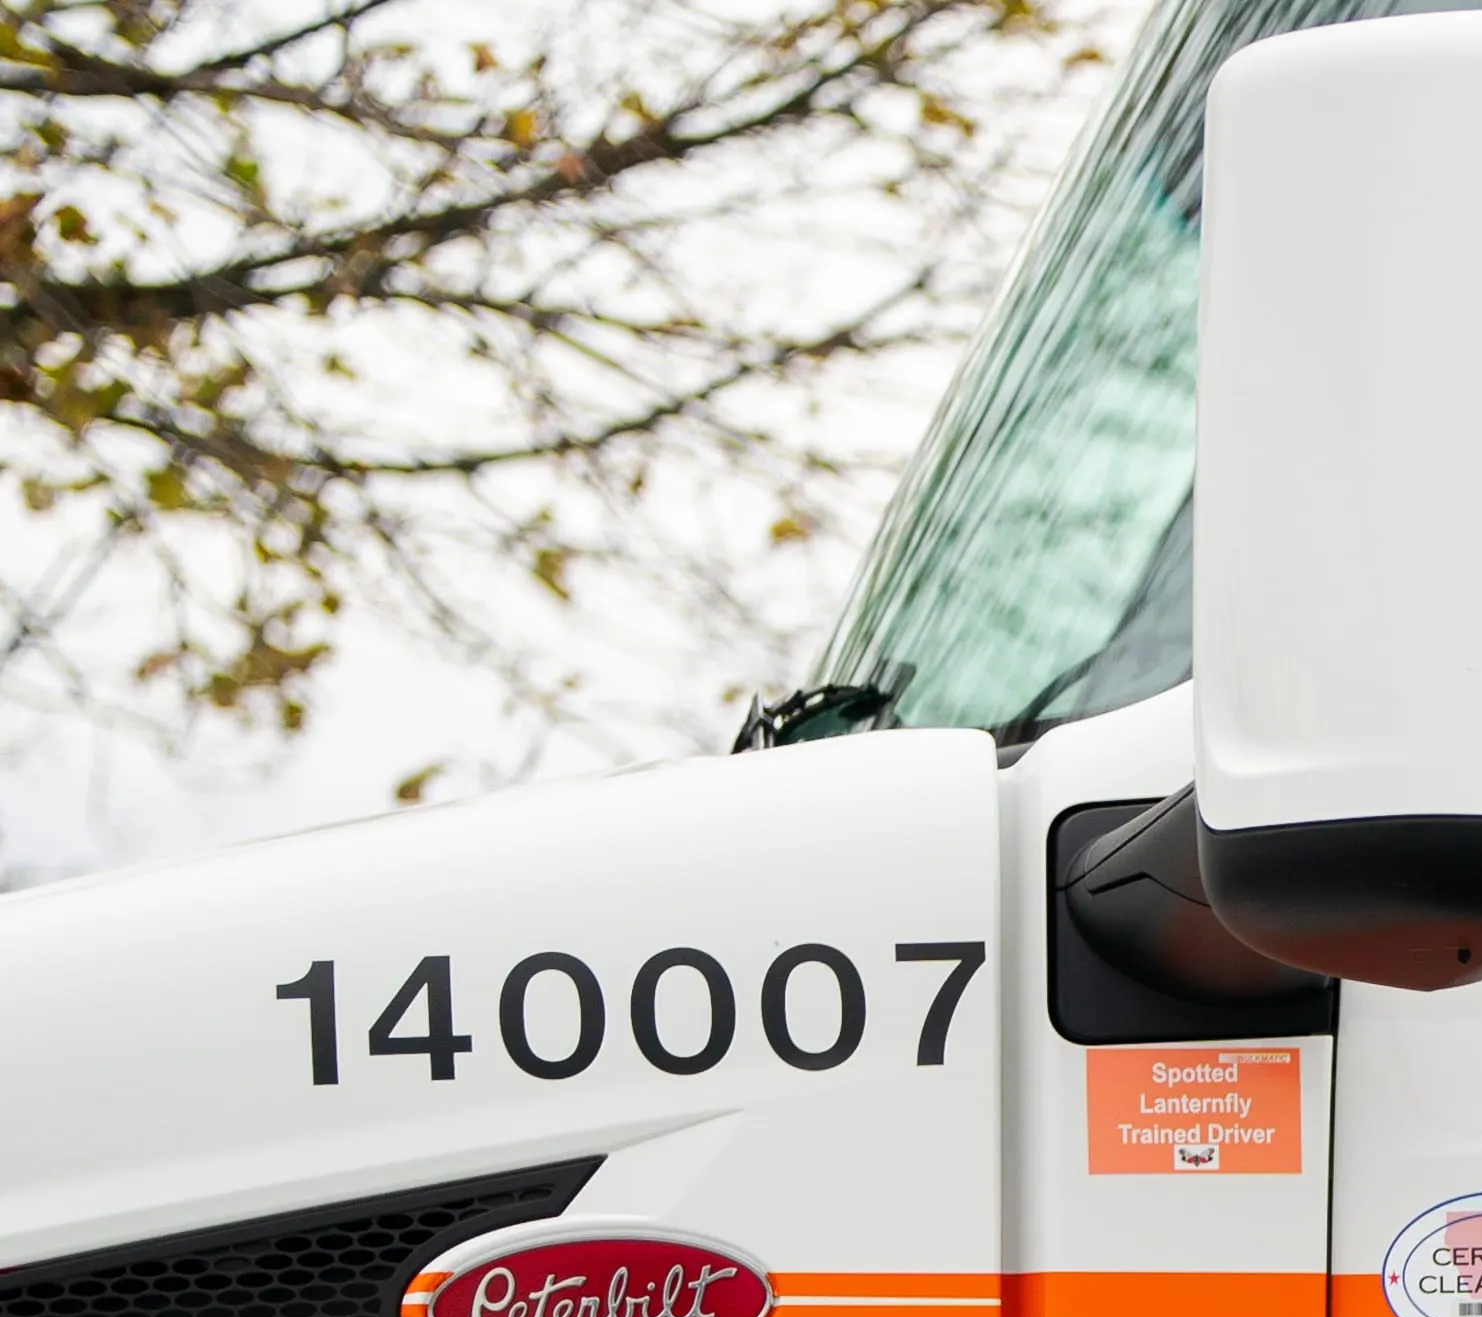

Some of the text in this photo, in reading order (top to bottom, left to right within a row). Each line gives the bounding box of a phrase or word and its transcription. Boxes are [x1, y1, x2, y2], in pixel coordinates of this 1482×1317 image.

[275, 941, 987, 1085] 140007
[1152, 1061, 1238, 1087] Spotted
[1140, 1093, 1252, 1118] Lanternfly
[1117, 1123, 1275, 1144] Trained Driver
